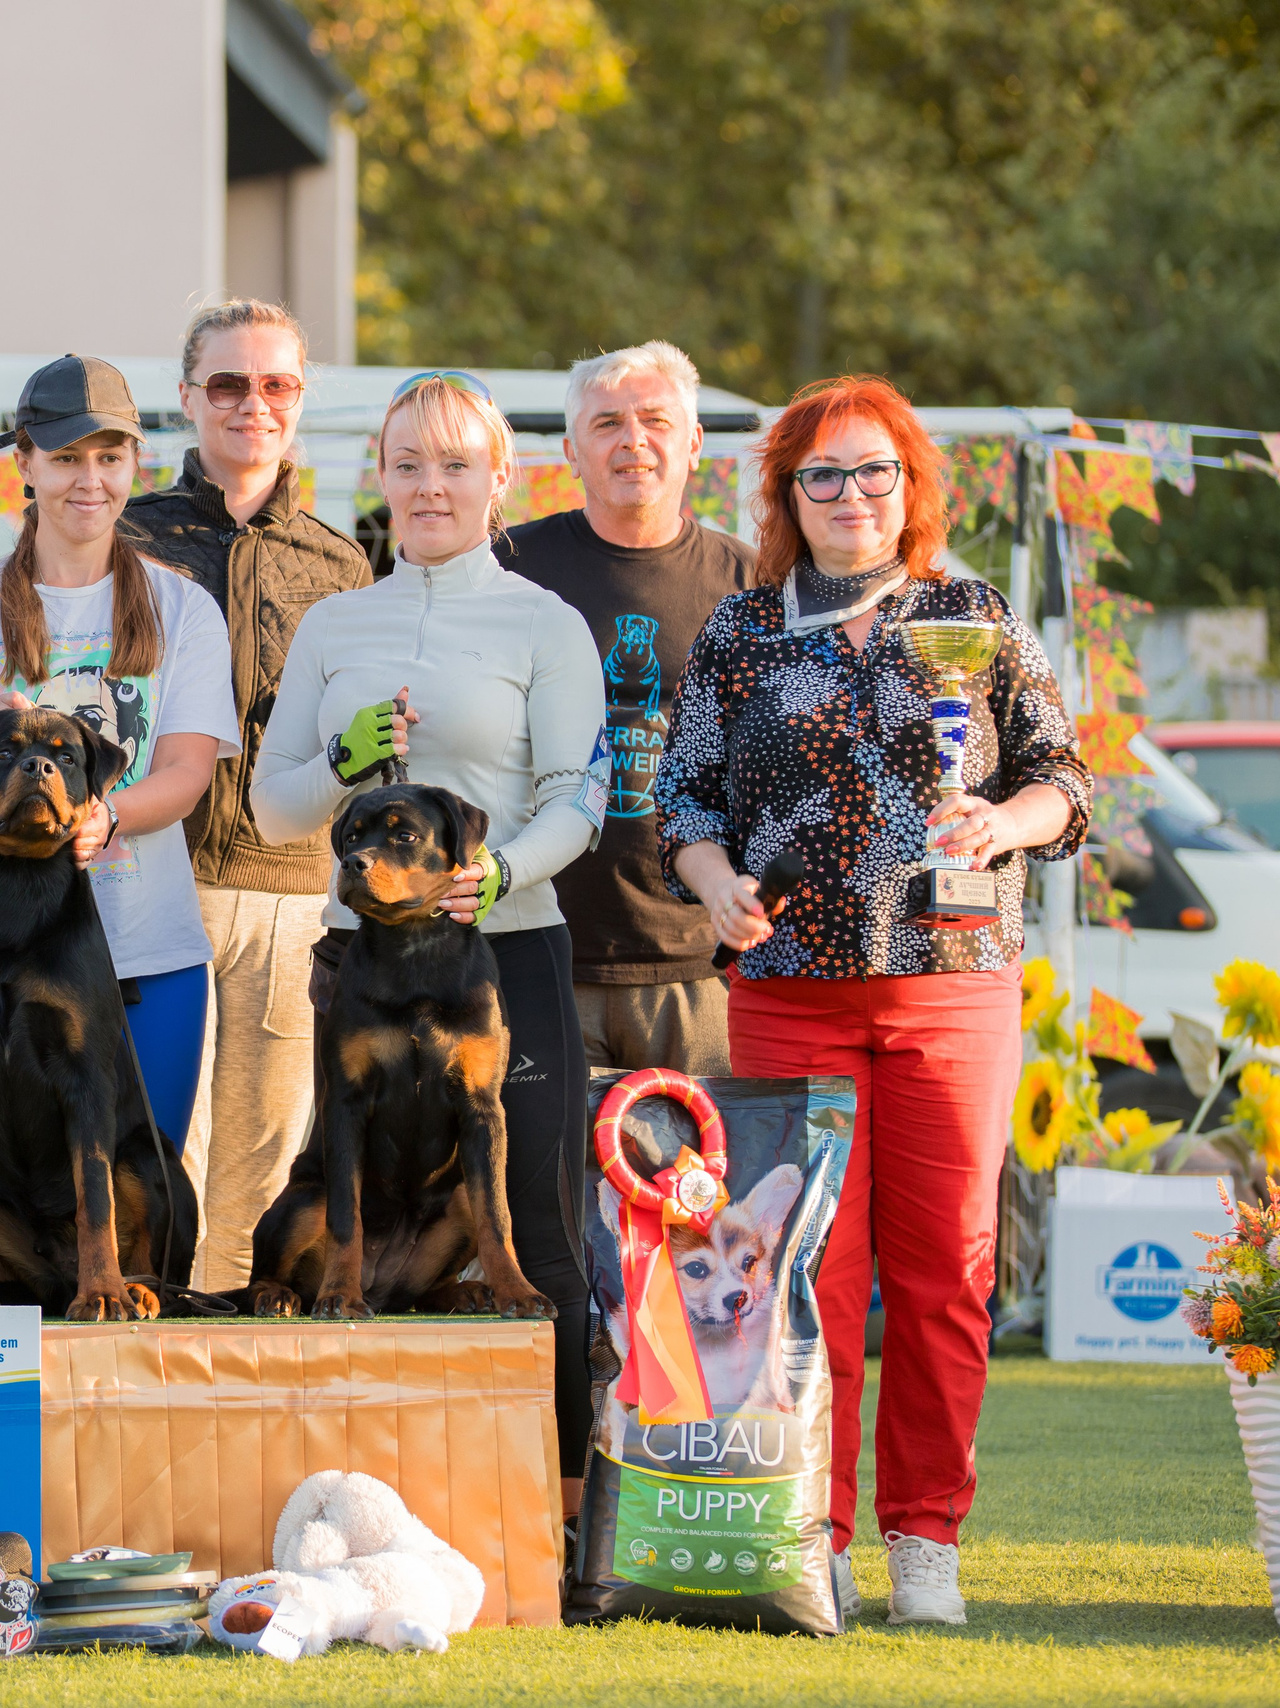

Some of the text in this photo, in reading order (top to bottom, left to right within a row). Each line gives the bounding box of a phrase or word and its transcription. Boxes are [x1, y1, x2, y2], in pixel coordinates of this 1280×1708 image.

[606, 726, 665, 749] ERRA
[642, 1419, 785, 1467] CIBAU
[657, 1488, 770, 1523] PUPPY
[641, 1526, 673, 1535] COMPLETE
[689, 1529, 722, 1537] BALANCED
[673, 1585, 742, 1596] GROWTH FORMULA
[272, 1622, 303, 1642] ECOPET
